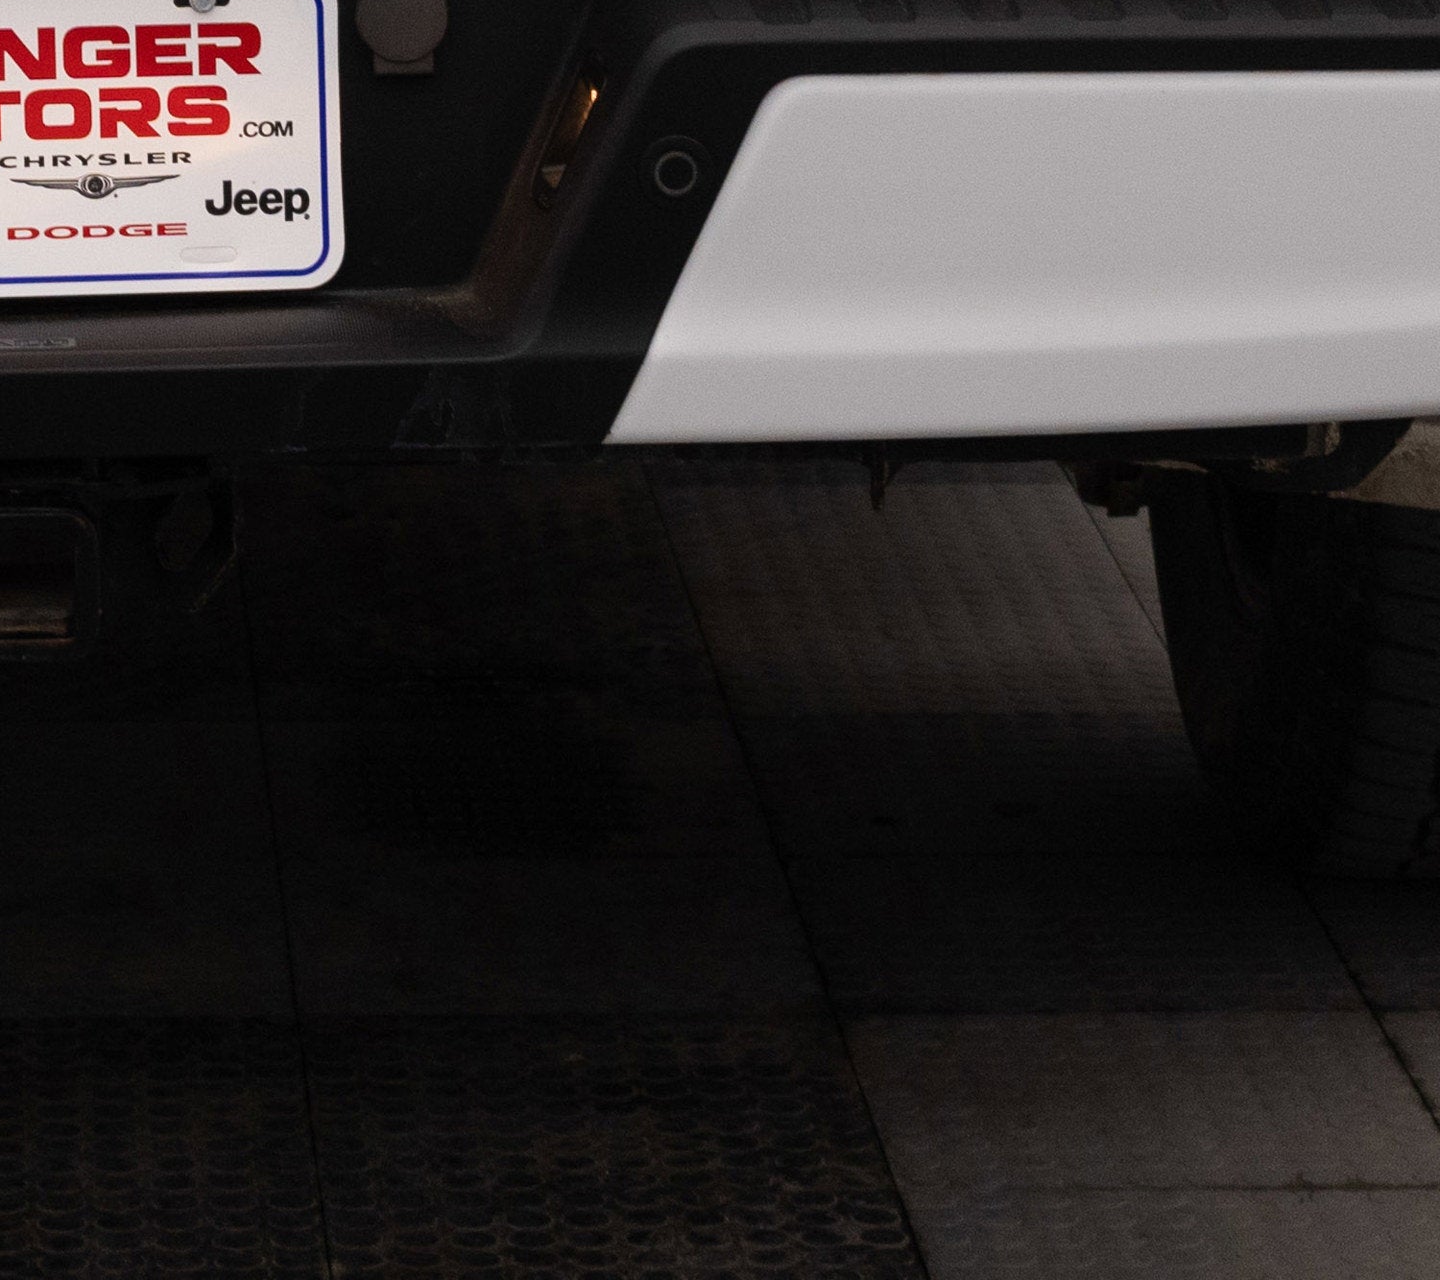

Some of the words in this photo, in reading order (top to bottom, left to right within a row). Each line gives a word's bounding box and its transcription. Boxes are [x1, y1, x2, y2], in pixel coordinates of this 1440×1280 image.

[238, 121, 294, 139] .COM
[204, 179, 311, 221] Jeep
[6, 222, 189, 241] DODGE
